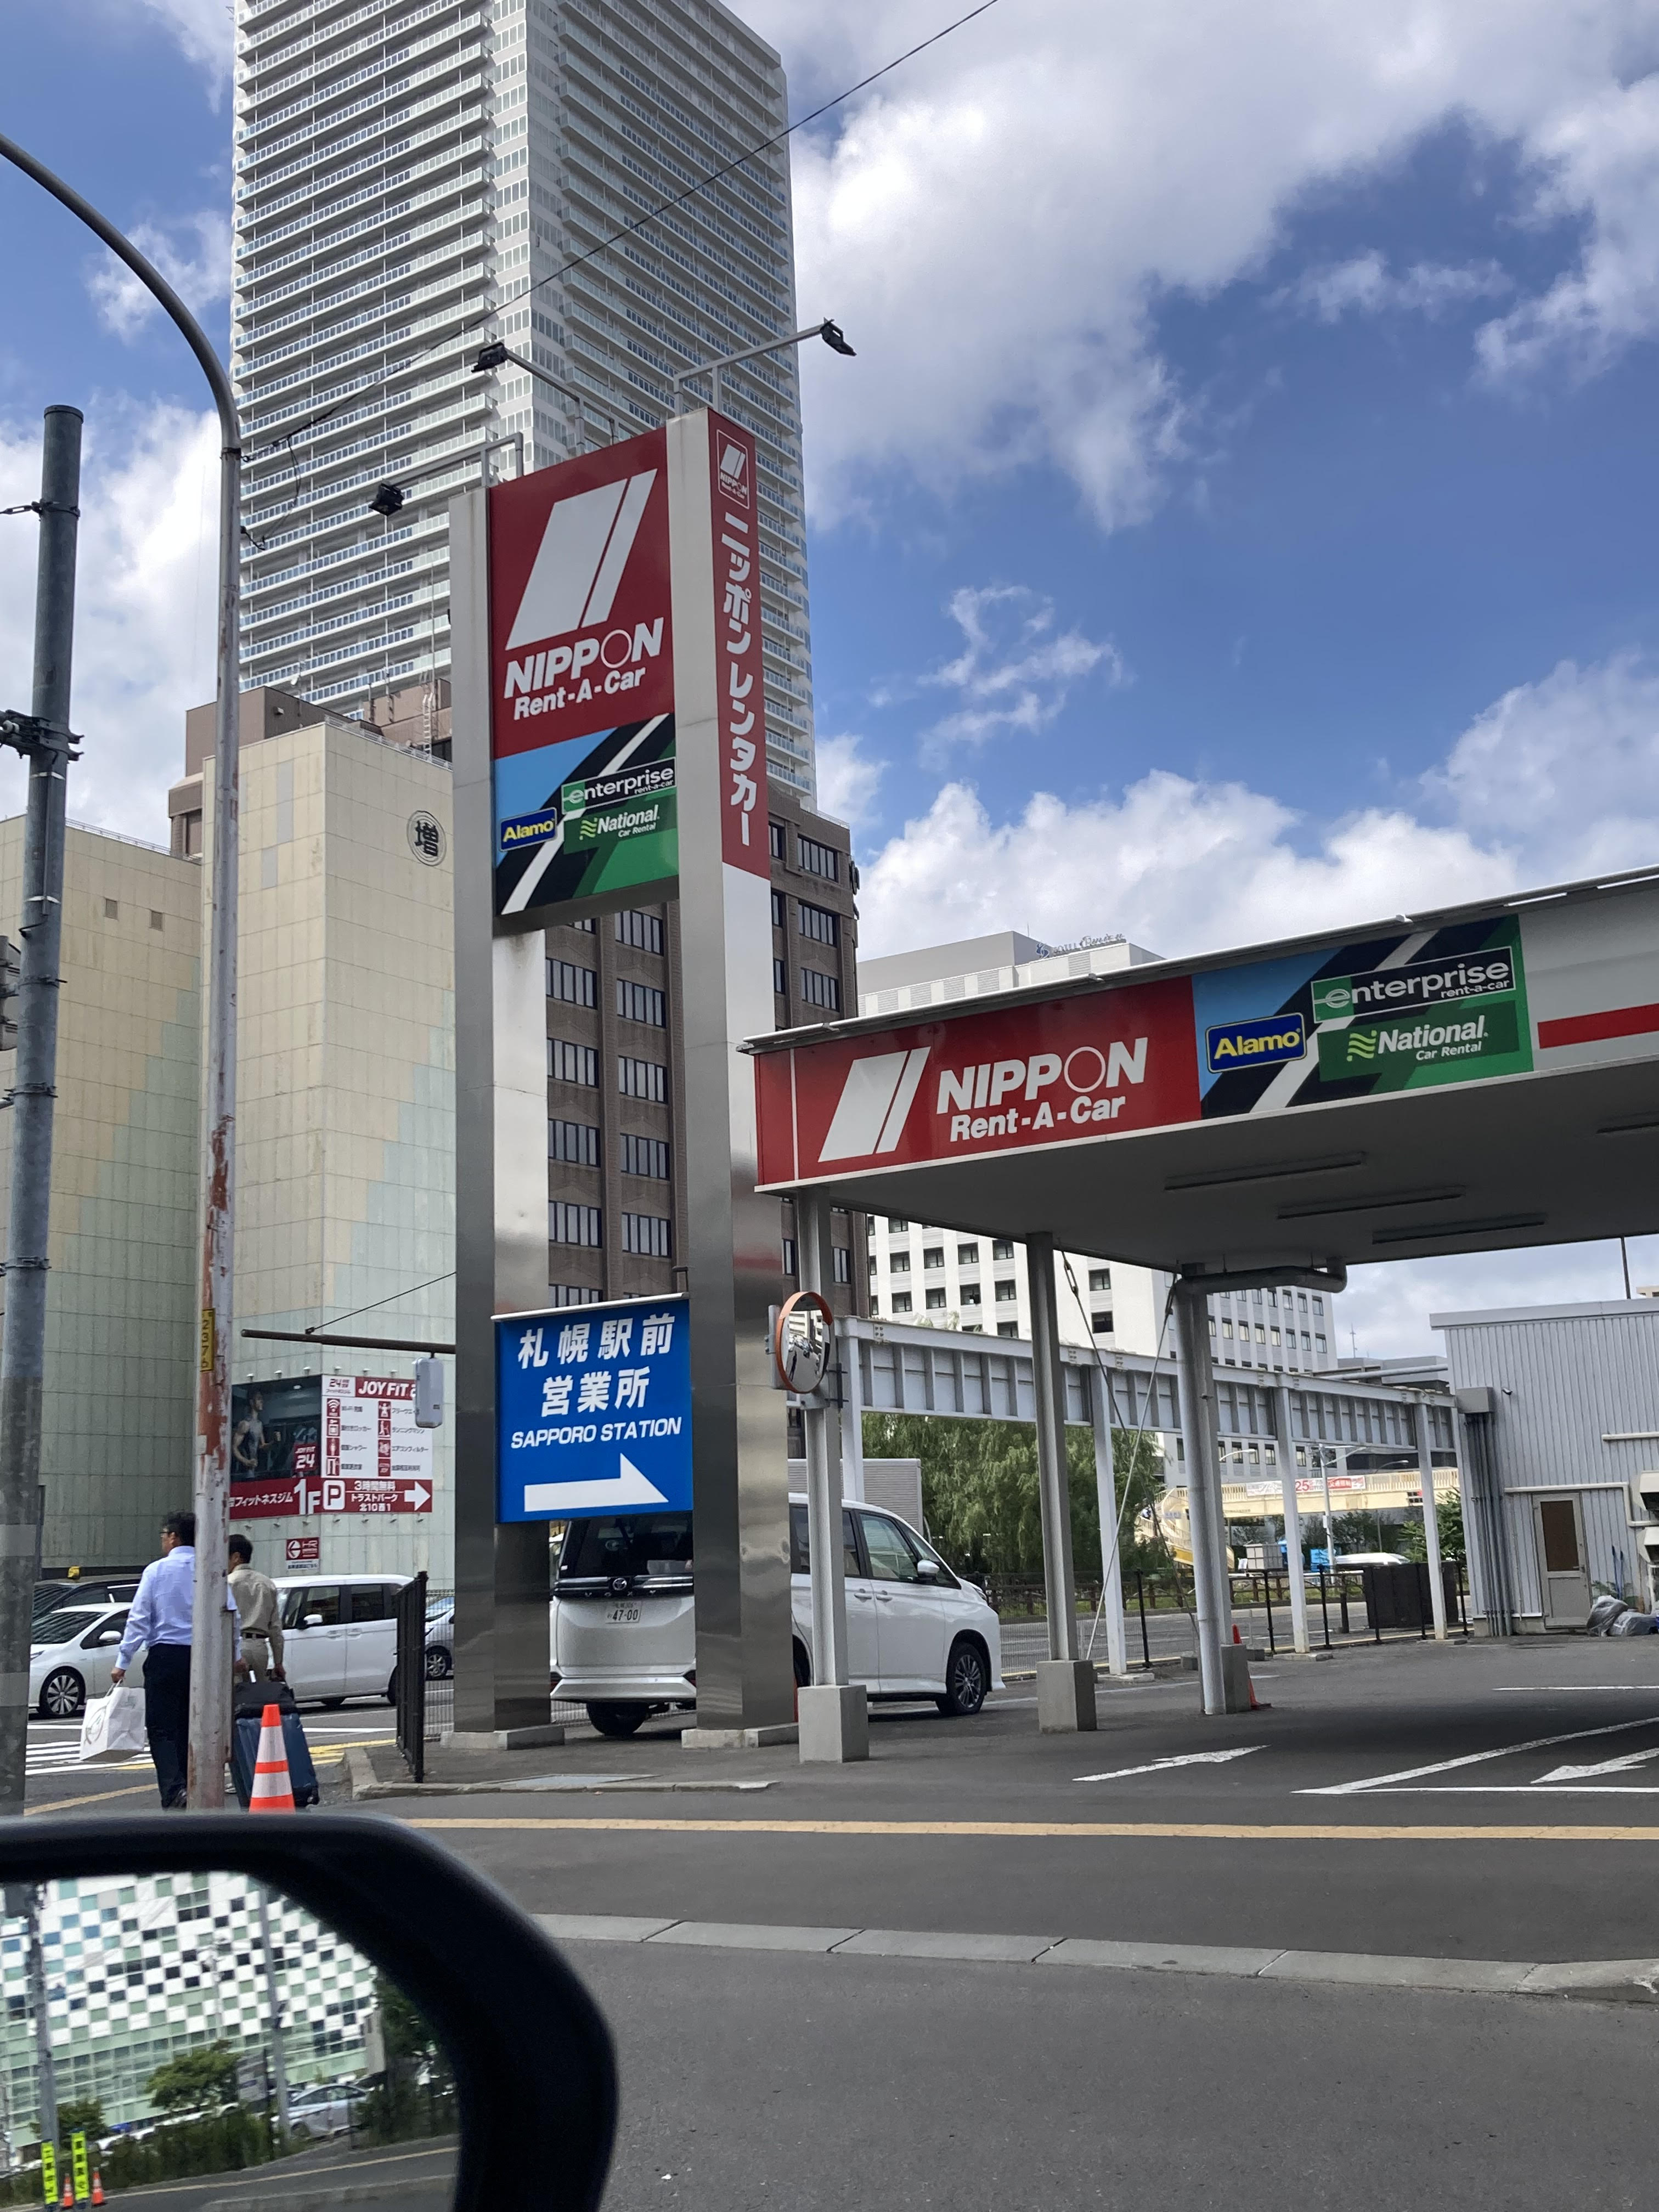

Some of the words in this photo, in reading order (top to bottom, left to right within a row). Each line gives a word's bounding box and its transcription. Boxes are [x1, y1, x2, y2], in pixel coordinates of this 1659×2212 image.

[504, 617, 664, 698] NIPPON
[565, 768, 674, 804] enterprise
[503, 820, 554, 842] Alamo
[597, 804, 658, 834] National
[618, 828, 630, 837] Car
[633, 823, 656, 834] Rental
[1322, 962, 1509, 1008] enterprise
[1441, 978, 1510, 998] rent-a-car
[1214, 1030, 1301, 1059] Alamo
[1378, 1015, 1485, 1054] National
[1415, 1047, 1437, 1061] Car
[1441, 1041, 1482, 1057] Rental
[936, 1037, 1148, 1115] NIPPON
[517, 1313, 675, 1369] 札幌駅前
[540, 1366, 651, 1418] 営業所
[511, 1424, 597, 1449] SAPPORO
[601, 1417, 682, 1442] STATION
[296, 1453, 315, 1469] 24
[294, 1479, 321, 1515] 1F
[612, 1609, 639, 1621] 47-00
